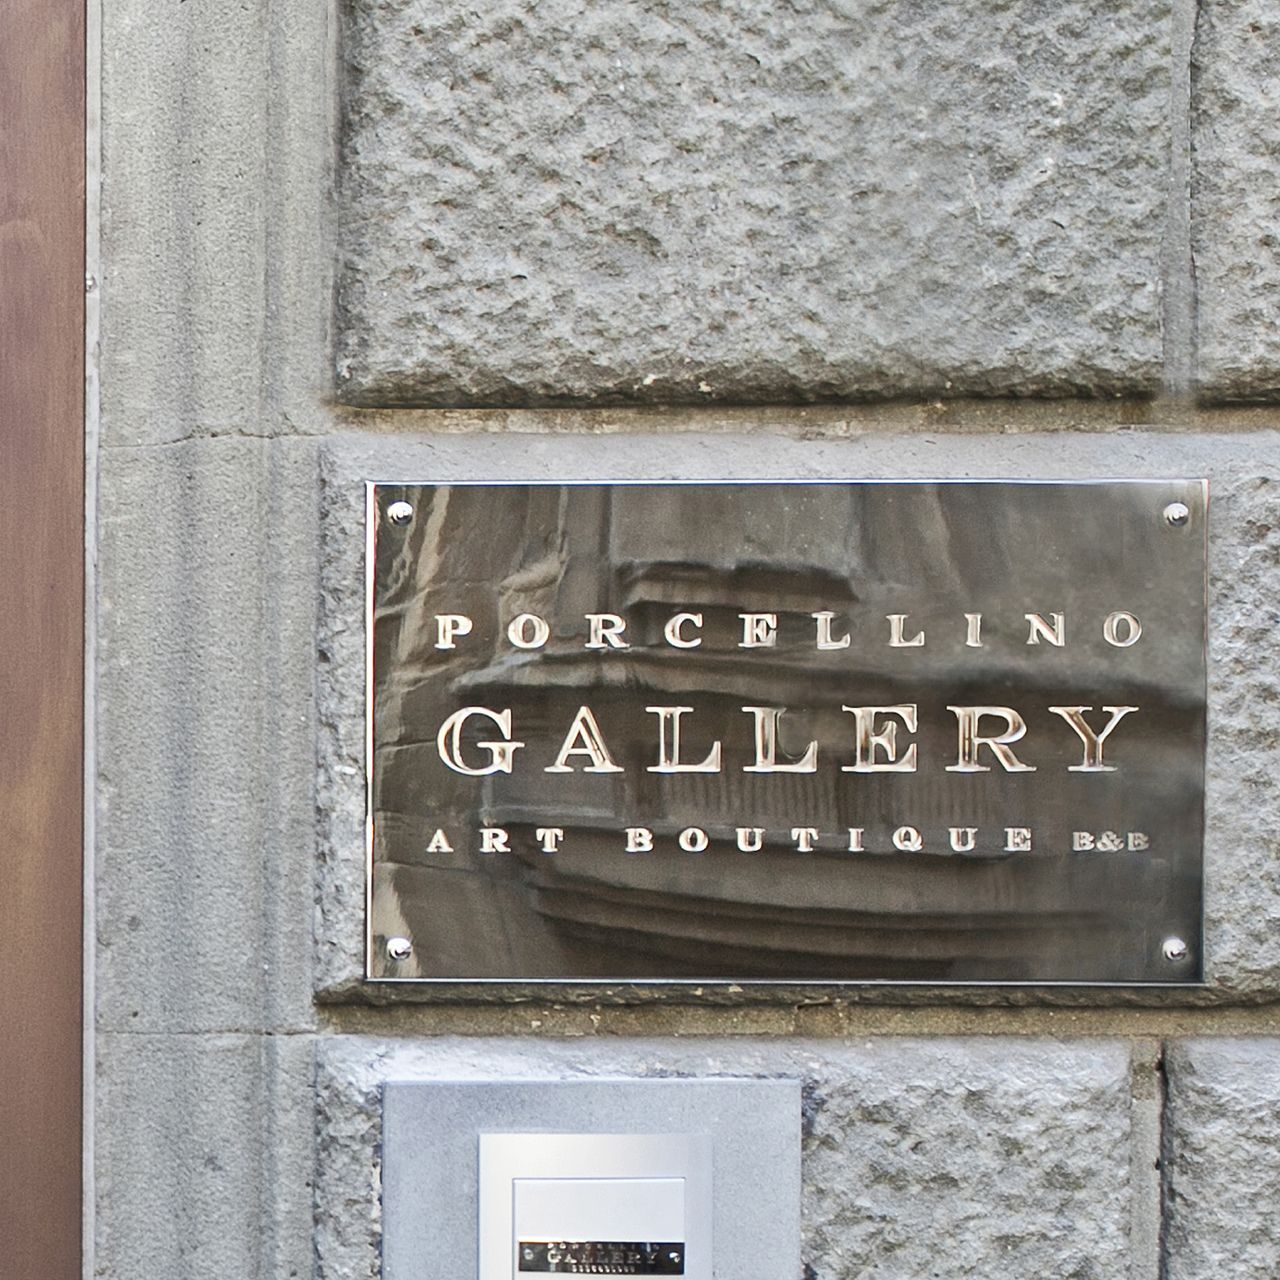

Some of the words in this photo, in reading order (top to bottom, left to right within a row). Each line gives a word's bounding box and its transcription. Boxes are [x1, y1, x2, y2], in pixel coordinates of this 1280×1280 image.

[434, 611, 1143, 650] PORCELLINO
[437, 704, 1140, 775] GALLERY
[426, 827, 564, 853] ART
[626, 826, 1032, 853] BOUTIQUE
[1072, 831, 1150, 851] B&B
[547, 1251, 658, 1264] GALLERY
